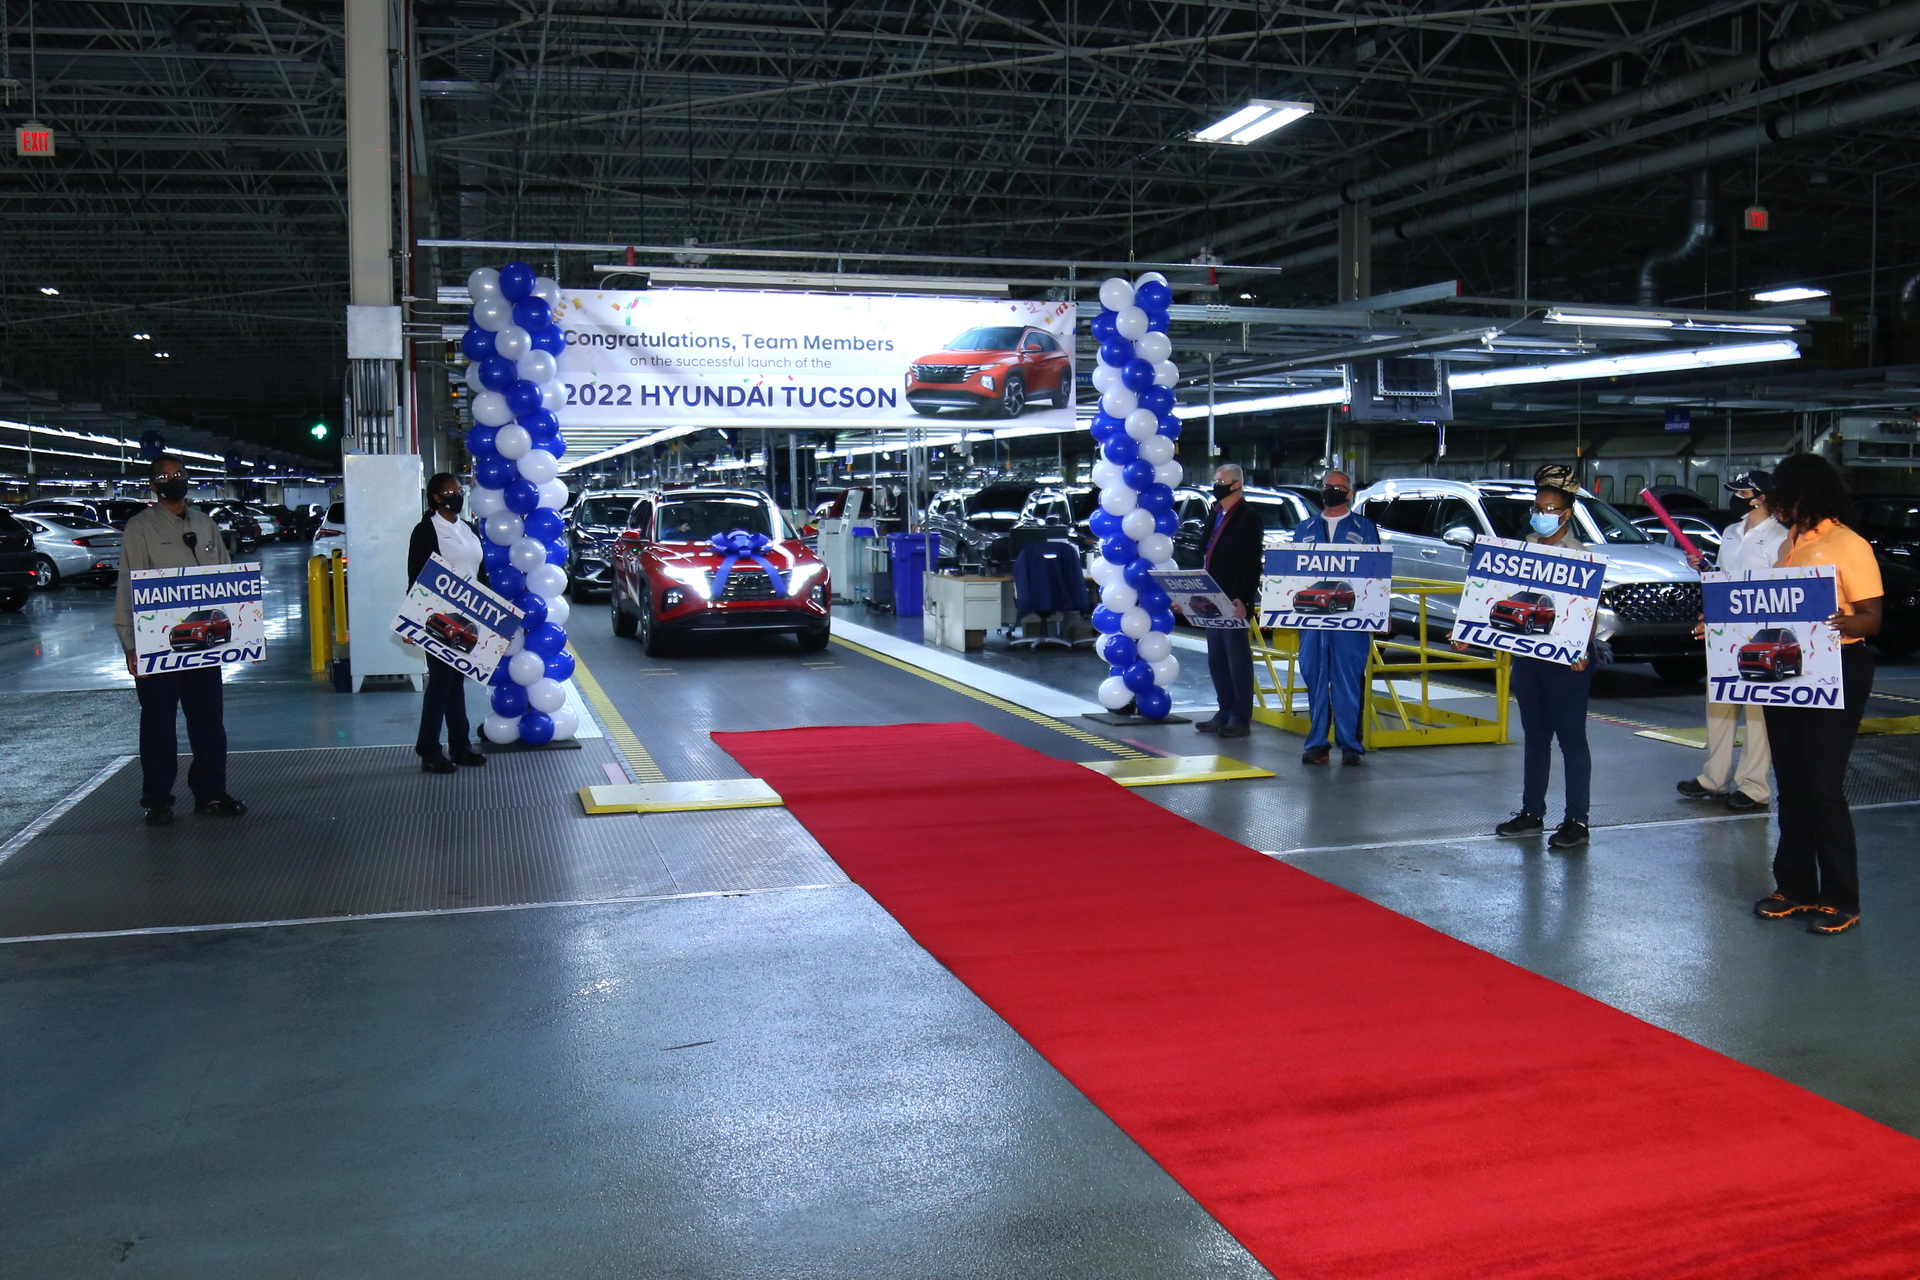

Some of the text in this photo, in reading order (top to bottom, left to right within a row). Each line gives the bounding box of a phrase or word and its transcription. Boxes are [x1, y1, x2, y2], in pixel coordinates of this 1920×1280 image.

[22, 131, 49, 152] EXIT
[564, 329, 894, 352] Congratulations, Team Members
[630, 355, 832, 369] on the successful launch of the
[565, 383, 897, 408] 2022 HYUNDAI TUCSON
[1296, 554, 1360, 573] PAINT
[1476, 551, 1597, 590] ASSEMBLY
[133, 580, 260, 605] MAINTENANCE
[1164, 578, 1208, 590] ENGINE
[435, 574, 508, 627] QUALITY
[1729, 587, 1805, 615] STAMP
[1186, 614, 1246, 627] TUCSON
[1263, 609, 1386, 630] TUCSON
[395, 615, 489, 682] TUCSON
[1457, 619, 1582, 664] TUCSON
[140, 646, 263, 673] TUCSON
[1710, 675, 1839, 706] TUCSON
